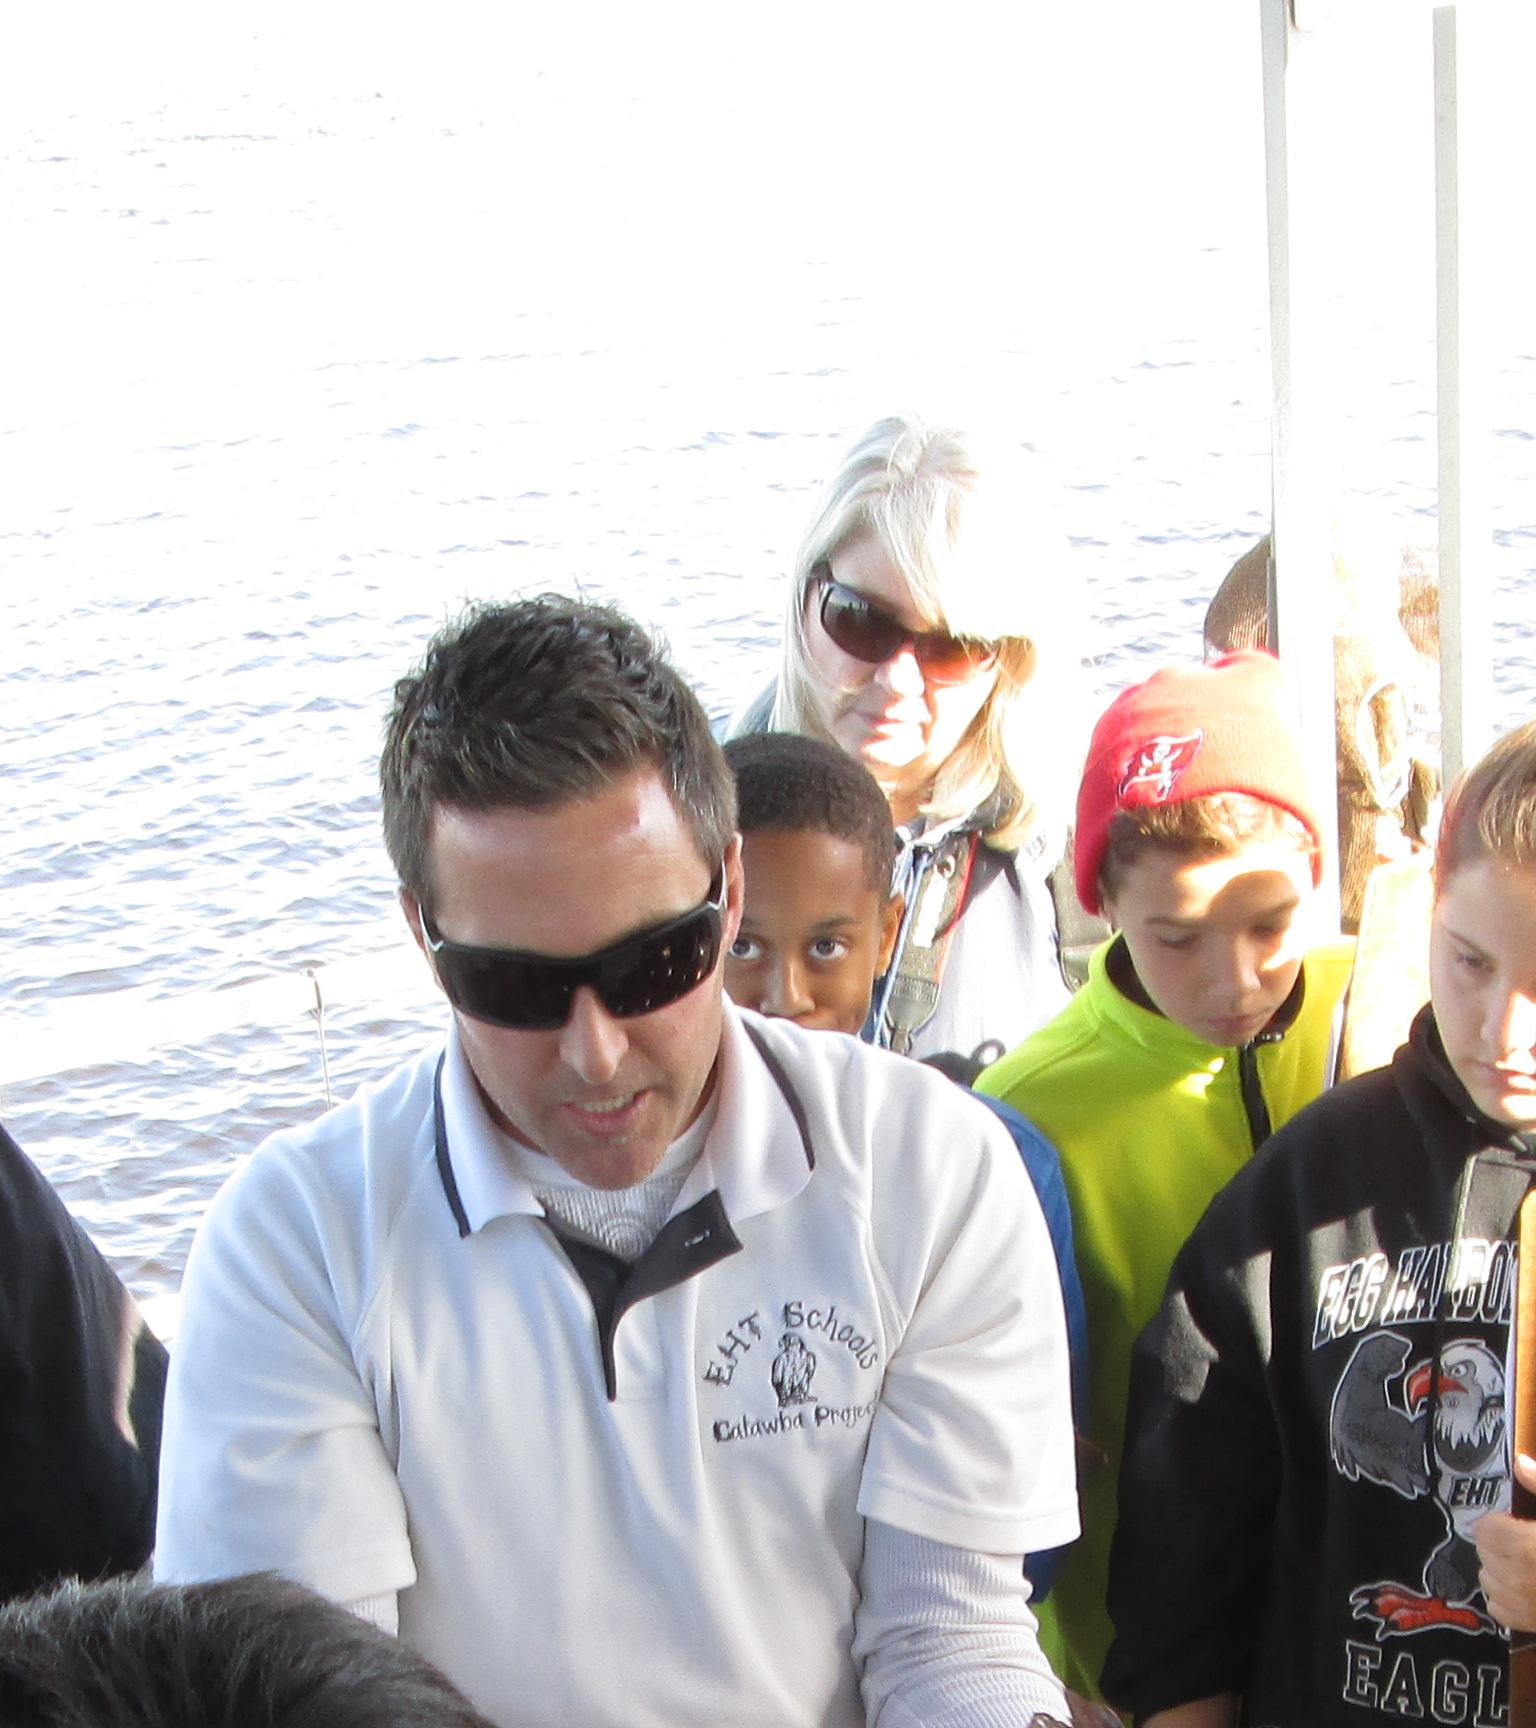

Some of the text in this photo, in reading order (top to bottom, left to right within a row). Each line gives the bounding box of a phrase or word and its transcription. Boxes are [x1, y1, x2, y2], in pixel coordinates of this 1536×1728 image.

[704, 1300, 878, 1387] EHT Schools
[1449, 1473, 1505, 1509] EHT
